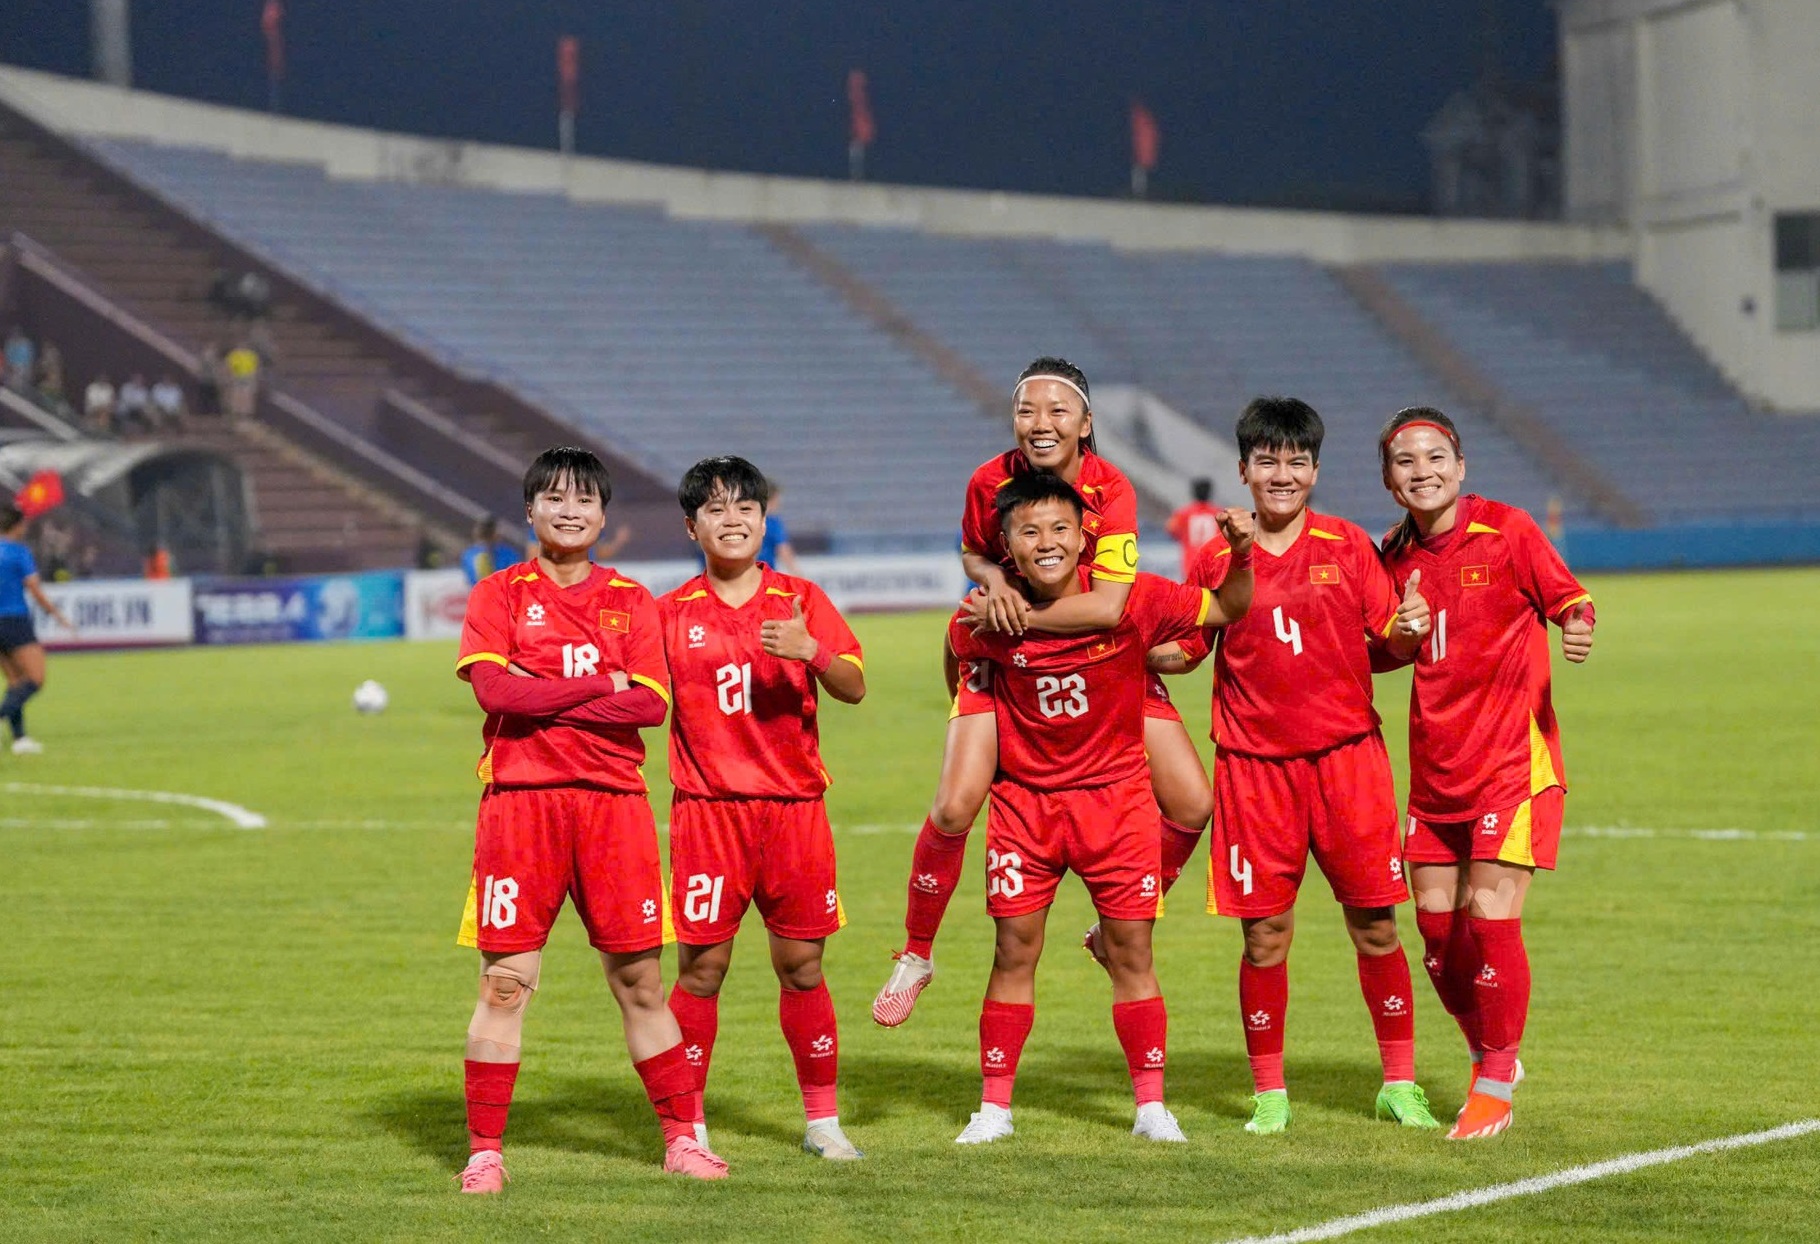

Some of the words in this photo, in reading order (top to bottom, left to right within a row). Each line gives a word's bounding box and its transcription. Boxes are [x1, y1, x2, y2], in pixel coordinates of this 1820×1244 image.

[1122, 539, 1138, 568] C
[1273, 606, 1303, 655] 4
[562, 643, 600, 679] 18
[716, 662, 753, 716] 21
[1036, 673, 1089, 719] 23
[987, 849, 1025, 899] 23
[1230, 845, 1253, 896] 4
[482, 874, 520, 930] 18
[684, 873, 725, 924] 21
